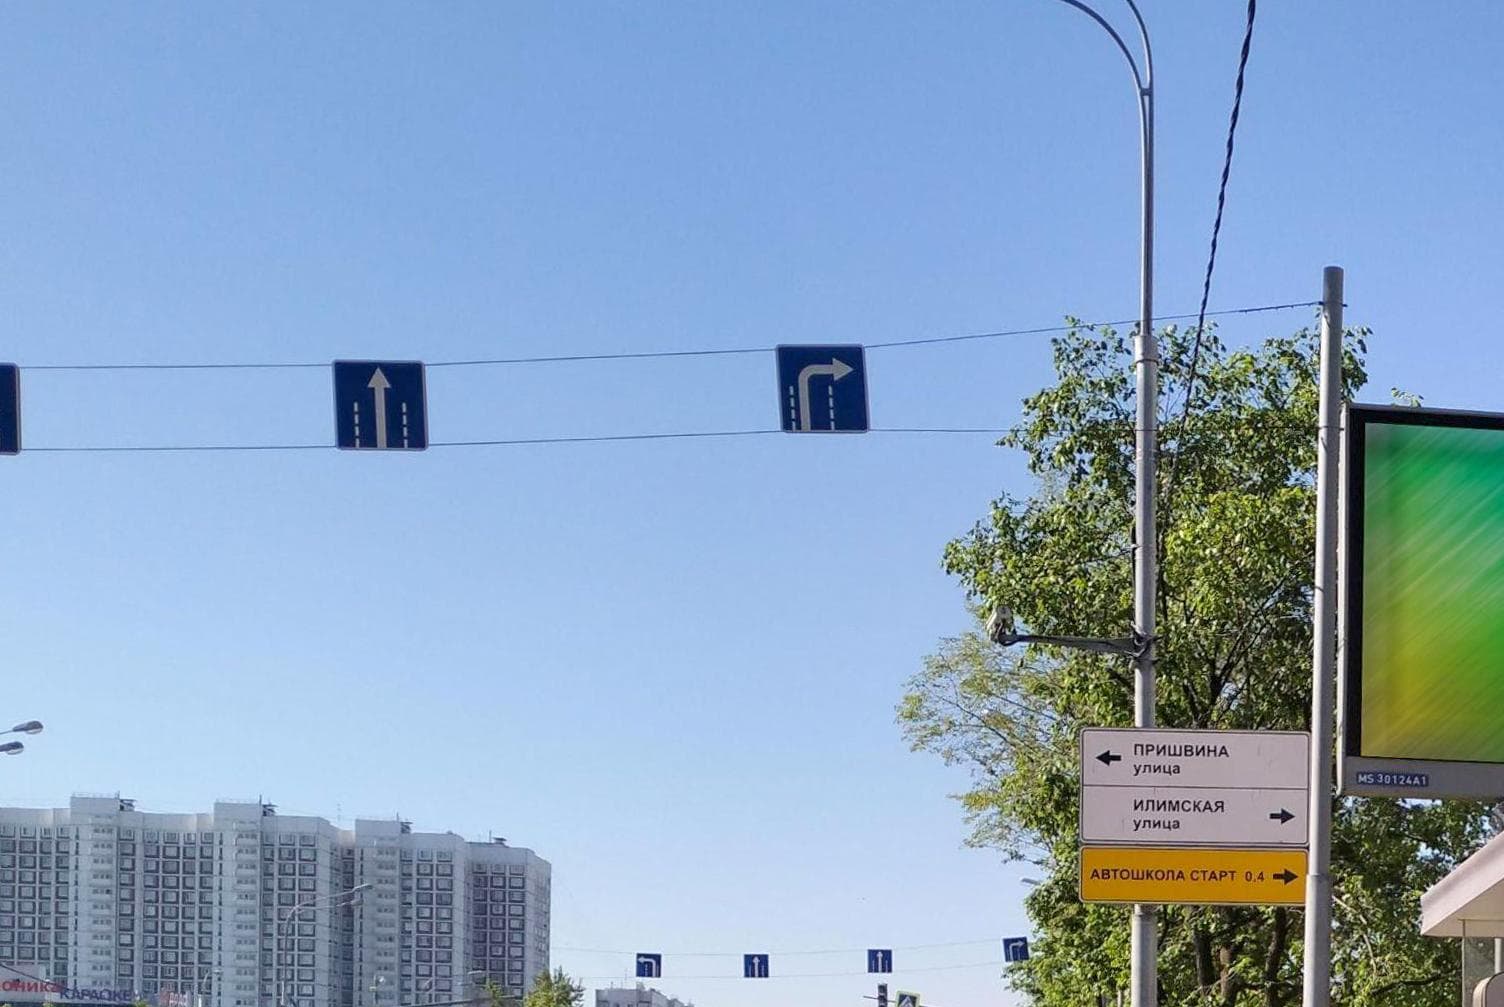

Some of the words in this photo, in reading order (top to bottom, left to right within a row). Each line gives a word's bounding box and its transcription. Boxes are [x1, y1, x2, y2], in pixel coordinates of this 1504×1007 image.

[1133, 743, 1230, 758] ПРИШВИНА
[1133, 763, 1181, 776] улица
[1133, 799, 1225, 813] ИЛИМСКАЯ
[1133, 819, 1181, 831] улица
[1089, 868, 1186, 882] АВТОШКОЛА
[1189, 869, 1237, 882] СТАРТ
